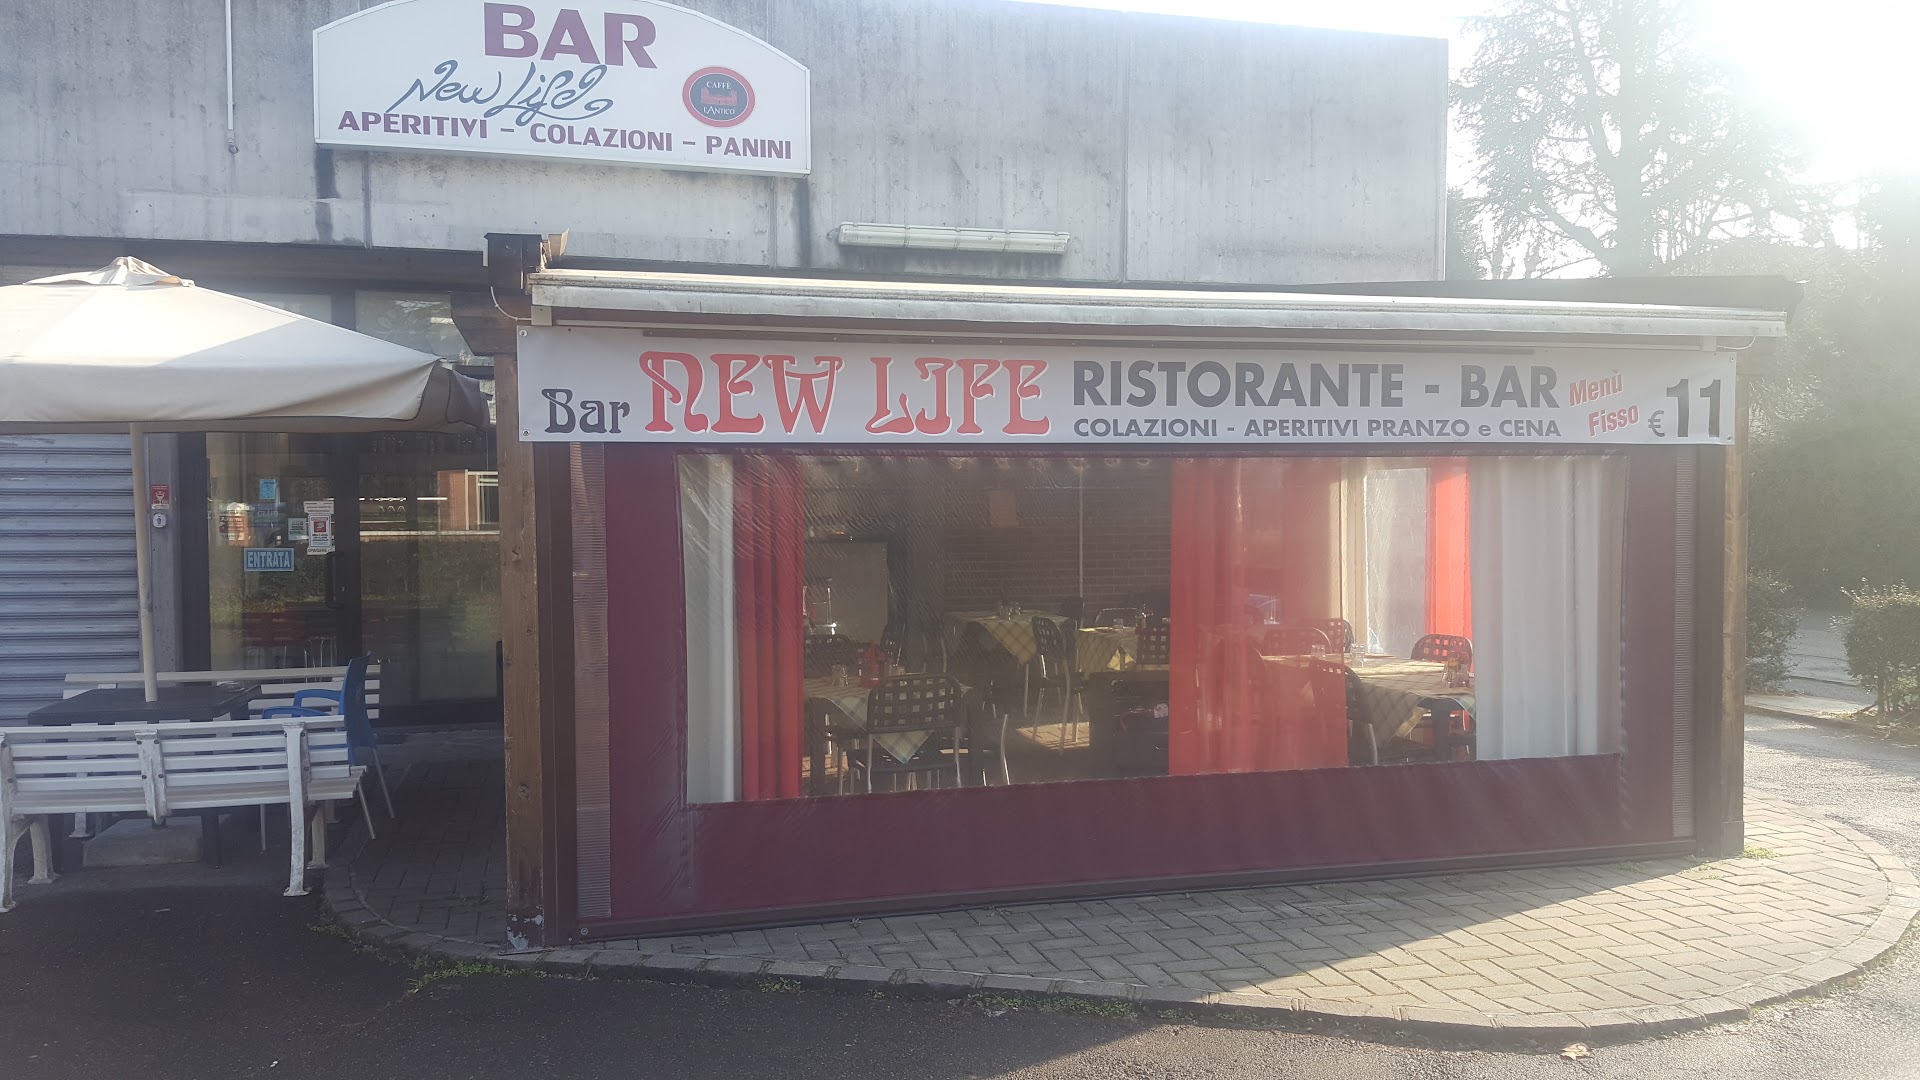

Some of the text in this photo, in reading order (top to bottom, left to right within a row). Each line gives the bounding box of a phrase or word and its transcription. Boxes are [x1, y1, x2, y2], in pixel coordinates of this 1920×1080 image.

[484, 2, 657, 69] BAR
[386, 59, 613, 126] New Life
[706, 81, 732, 90] CAFFÈ
[338, 110, 488, 139] APERITIVI
[529, 122, 673, 152] COLAZIONI
[706, 135, 792, 159] PANINI
[541, 387, 630, 434] Bar
[638, 350, 845, 436] NEW
[864, 355, 1051, 436] LIFE
[1073, 360, 1405, 409] RISTORANTE
[1460, 364, 1561, 409] BAR
[1569, 370, 1624, 407] Menù
[1647, 378, 1721, 438] € 11
[1073, 417, 1218, 438] COLAZIONI
[1244, 417, 1358, 438] APERITIVI
[1367, 417, 1470, 438] PRANZO
[1478, 422, 1492, 438] e
[1498, 417, 1562, 438] CENA
[1588, 404, 1640, 437] Fisso
[247, 551, 291, 568] ENTRATA
